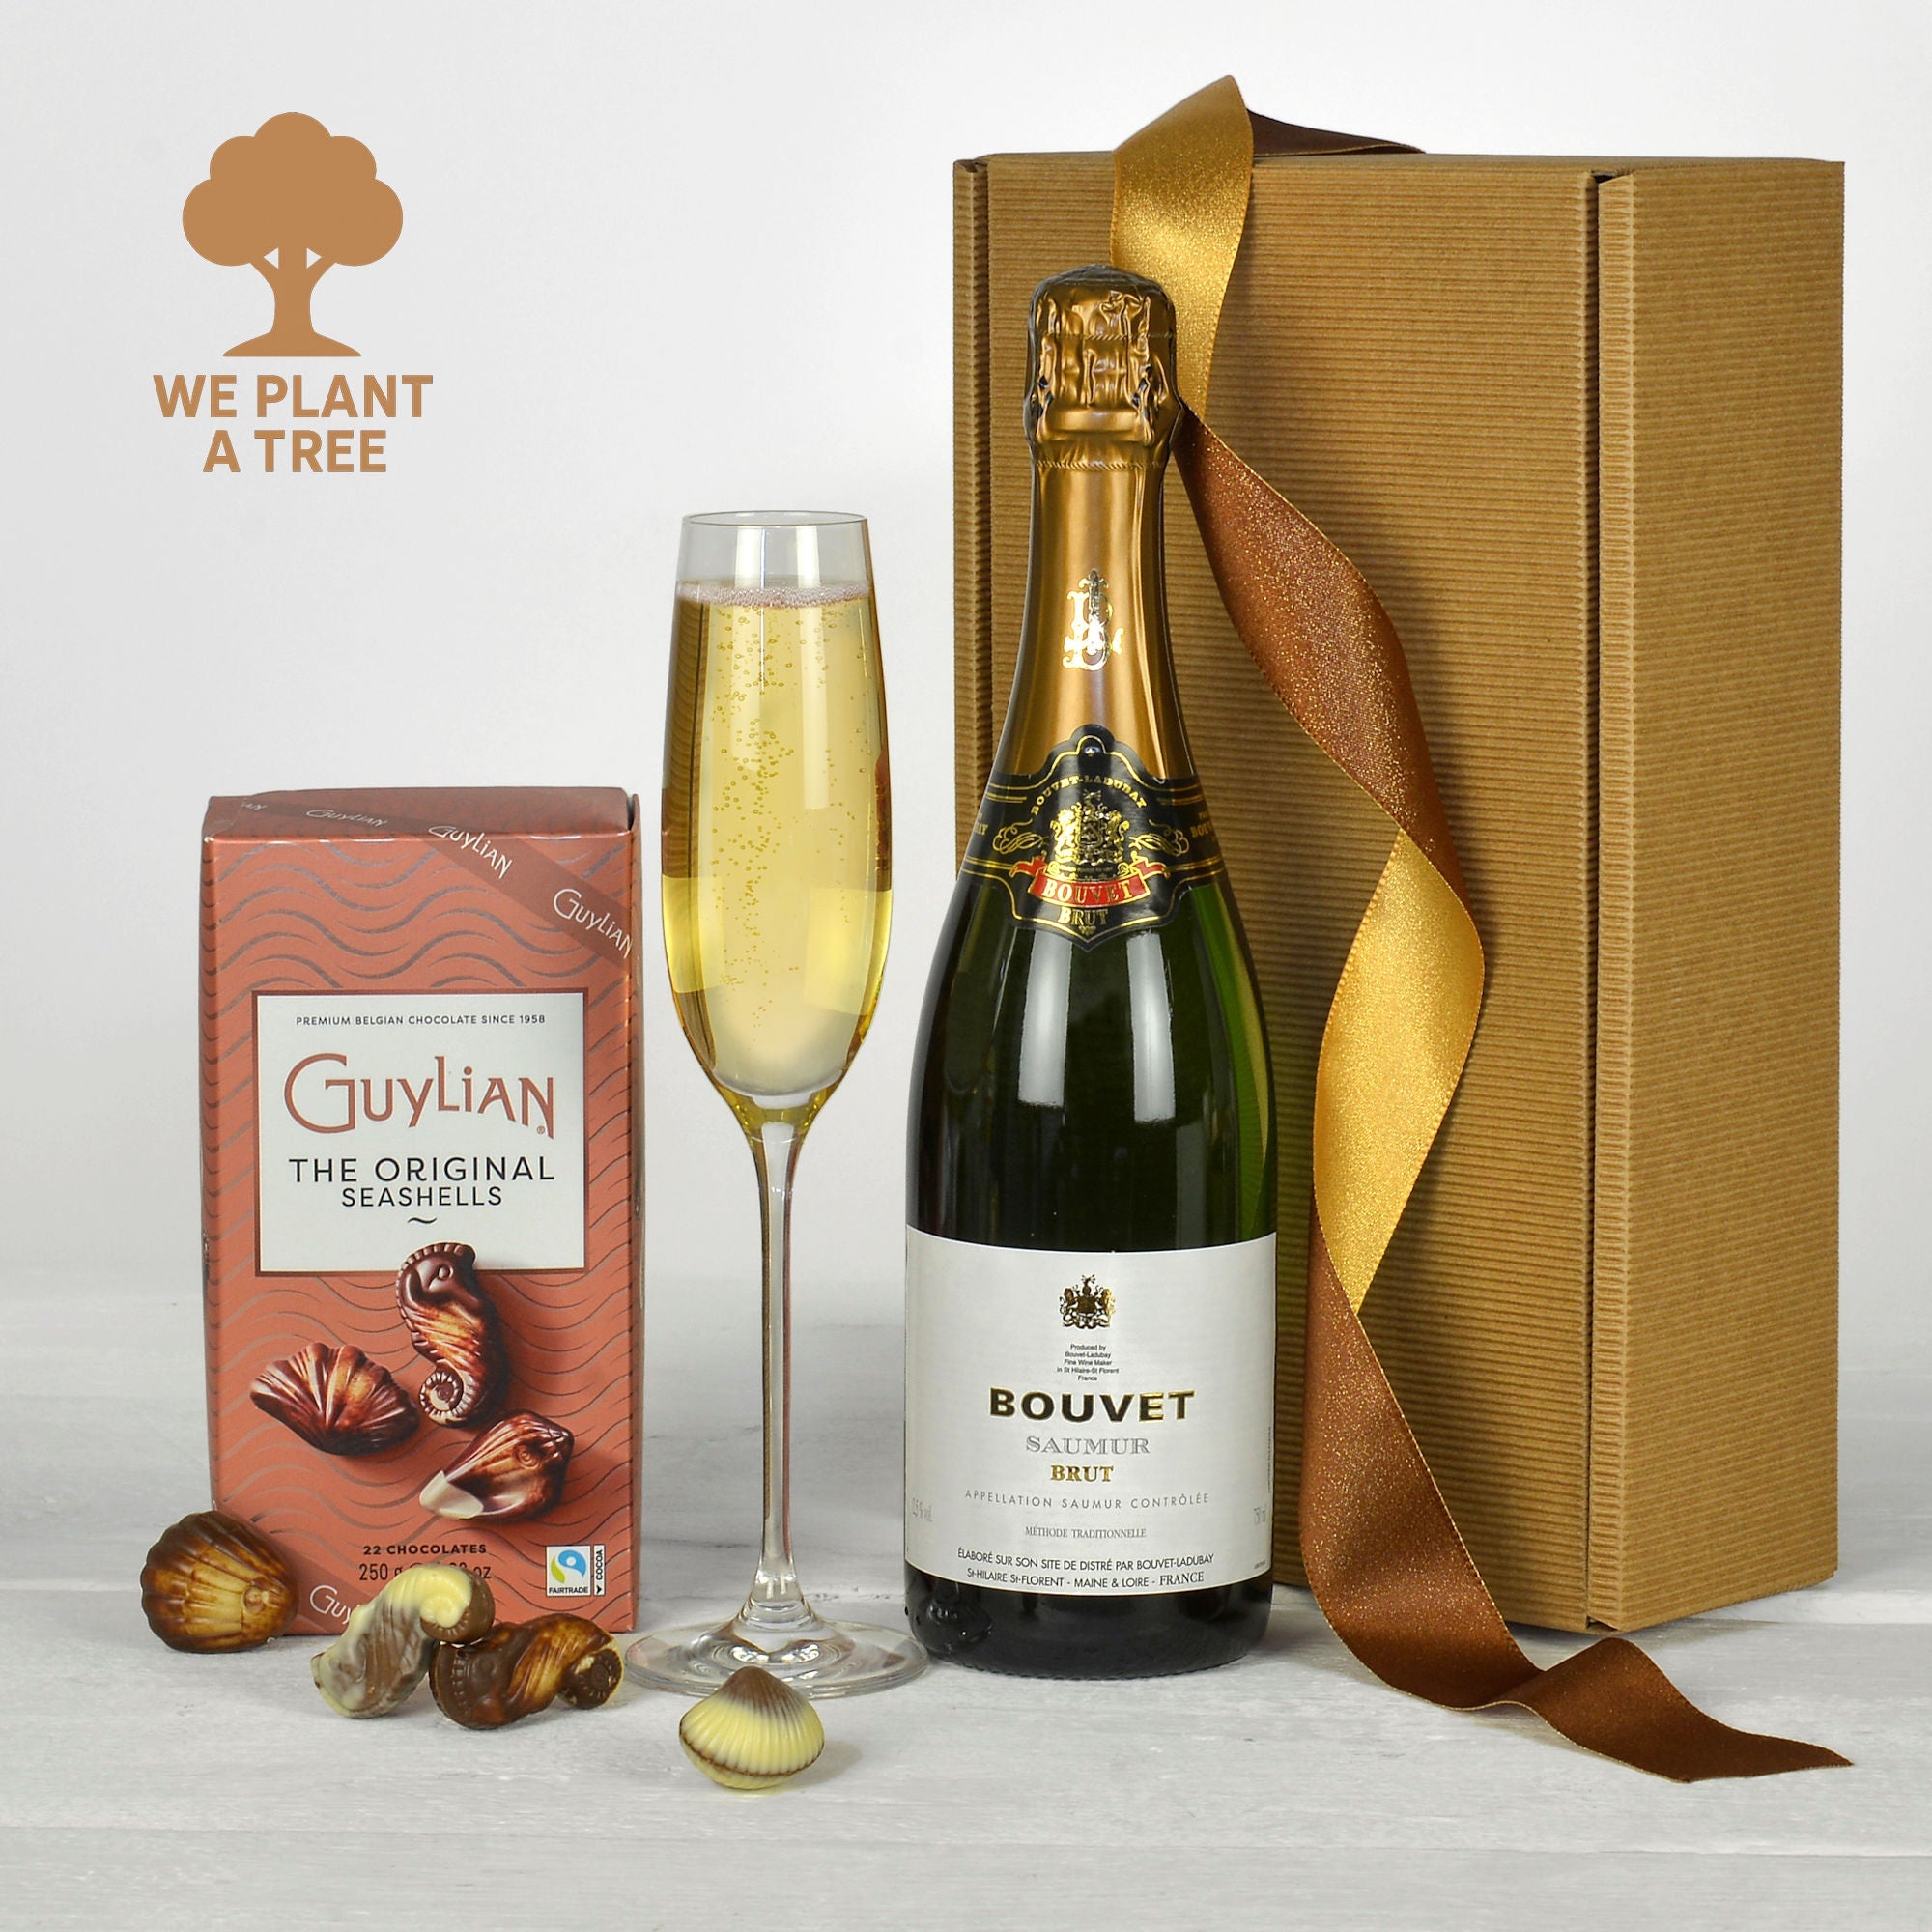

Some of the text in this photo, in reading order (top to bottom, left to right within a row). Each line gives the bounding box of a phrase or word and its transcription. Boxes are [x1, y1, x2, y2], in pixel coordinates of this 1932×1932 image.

[1041, 880, 1133, 904] BOUVET
[1057, 907, 1108, 925] BRUT
[296, 1014, 546, 1026] PREMIUM BELGIAN CHOCOLATE SINCE 1958
[289, 1156, 554, 1183] THE ORIGINAL
[341, 1186, 502, 1208] SEASHELLS
[988, 1387, 1195, 1423] BOUVET
[1026, 1435, 1150, 1455] SAUMUR
[1050, 1464, 1114, 1482] BRUT
[965, 1490, 1208, 1509] APPELLATION SAUMUR CONTRÔLÉE
[1025, 1524, 1147, 1538] MÉTHODE TRADITIONNELLE
[363, 1544, 486, 1555] 22 CHOCOLATES
[957, 1547, 1214, 1571] ÉLABORÉ SUR SON SITE DE DISTRÉ PAR BOUVET-LADUBAY
[359, 1563, 388, 1580] 250
[473, 1566, 491, 1578] oz
[1074, 1577, 1107, 1588] MAINE
[1111, 1578, 1119, 1587] &
[1122, 1577, 1149, 1587] LOIRE
[1159, 1571, 1205, 1586] FRANCE
